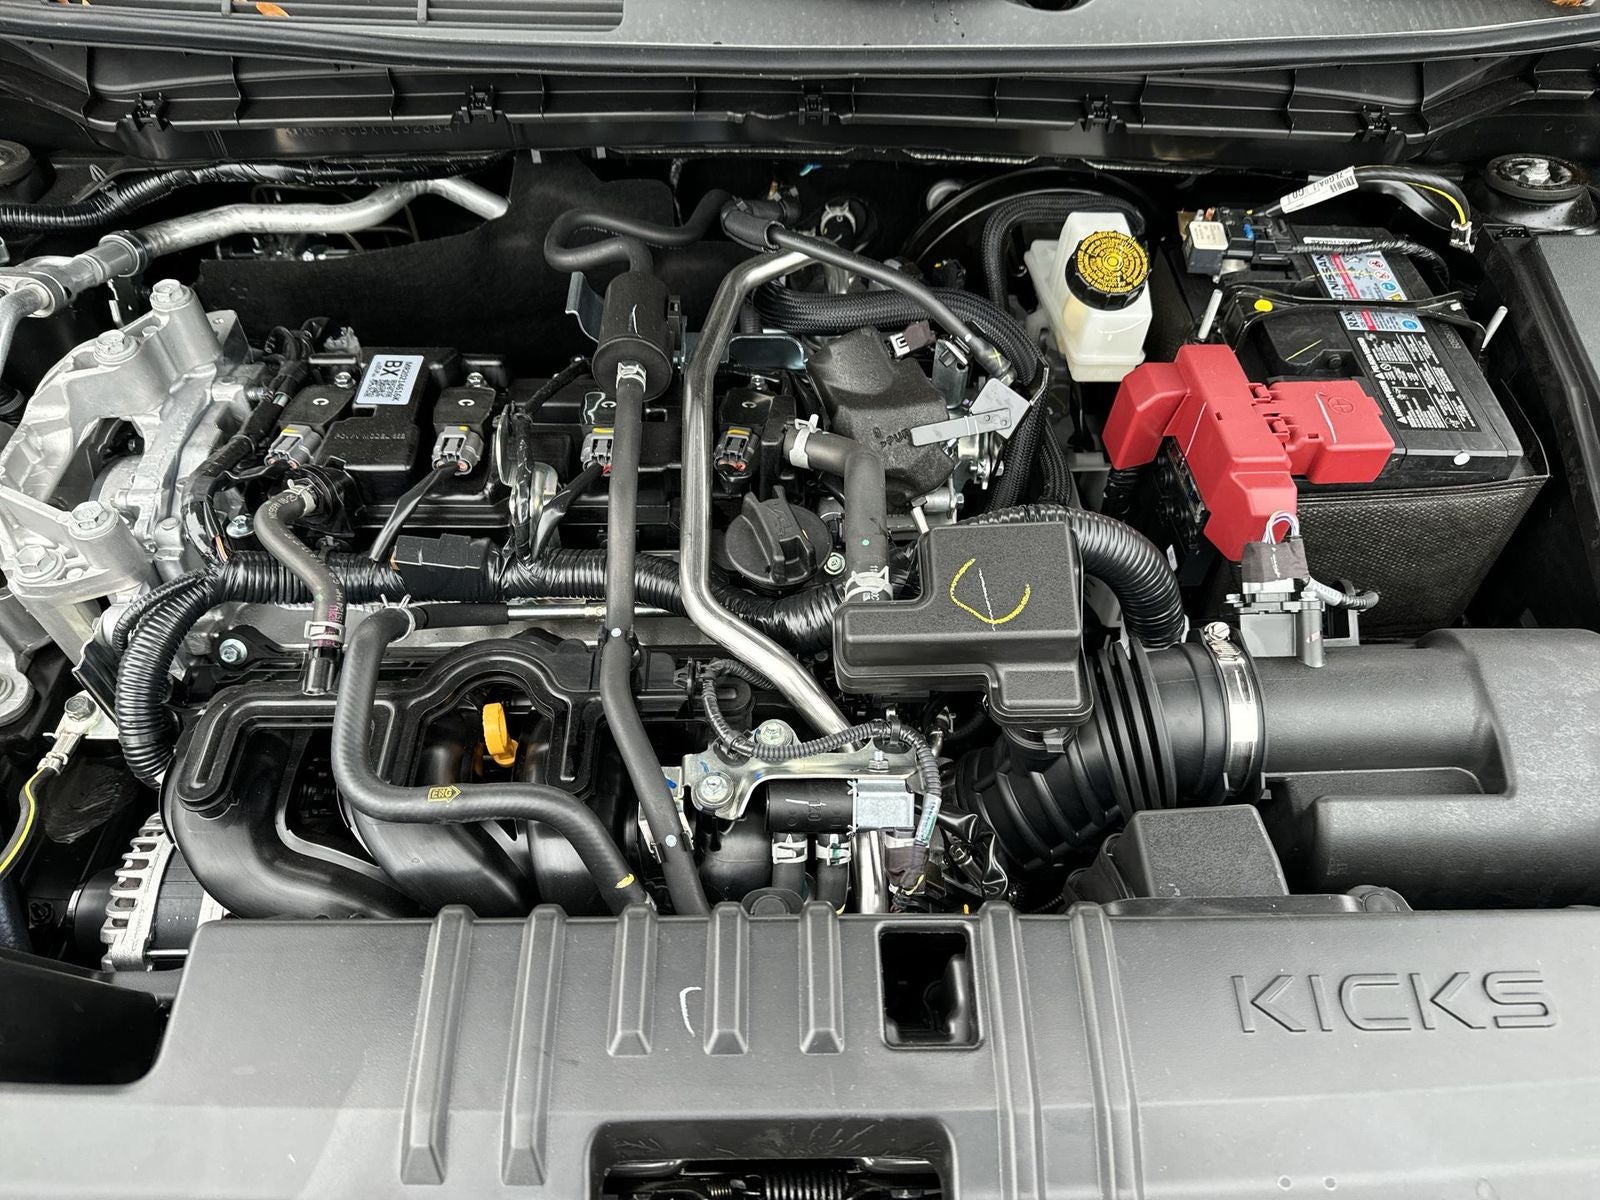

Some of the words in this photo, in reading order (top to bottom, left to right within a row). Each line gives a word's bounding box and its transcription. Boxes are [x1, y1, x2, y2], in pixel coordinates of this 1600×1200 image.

[380, 360, 404, 377] BX
[431, 788, 453, 799] ENG
[1231, 970, 1561, 1033] KICKS
